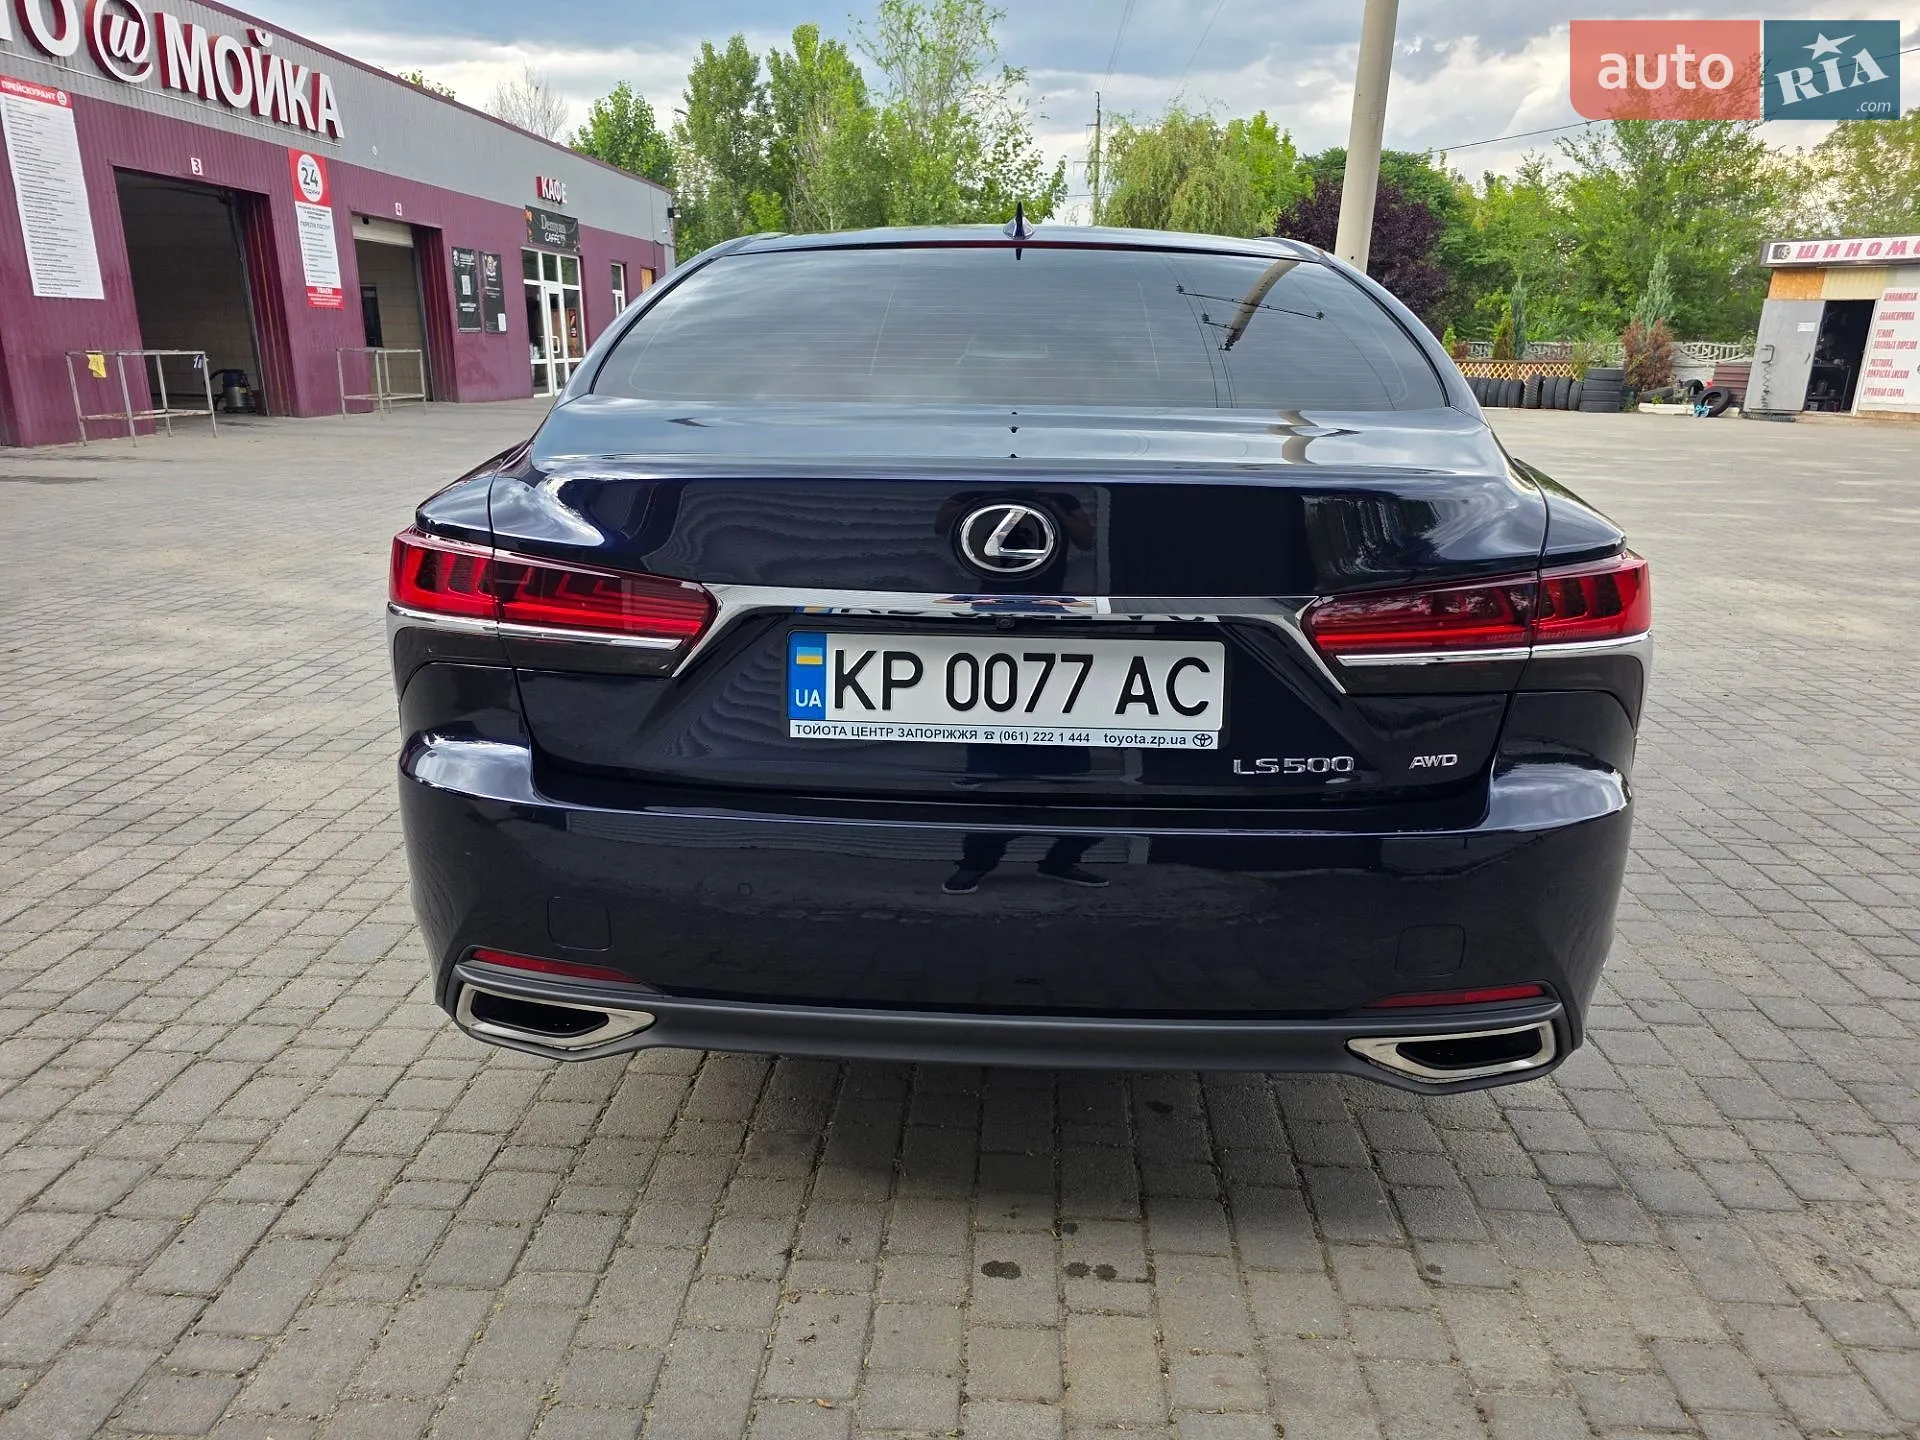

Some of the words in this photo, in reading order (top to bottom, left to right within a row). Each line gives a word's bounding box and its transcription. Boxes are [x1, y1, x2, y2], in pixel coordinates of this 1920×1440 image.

[0, 0, 80, 57] О
[157, 12, 345, 139] МОЙКА
[192, 159, 201, 174] 3
[301, 167, 319, 188] 24
[537, 175, 568, 204] КАФЕ
[834, 649, 924, 711] KP
[945, 652, 1094, 714] 0077
[1114, 655, 1210, 717] AC
[795, 689, 822, 708] UA
[795, 723, 847, 736] ТОЙОТА
[851, 726, 894, 739] ЦЕНТР
[897, 728, 978, 740] ЗАПОРІЖЖЯ
[999, 730, 1029, 743] (061)
[1033, 731, 1054, 742] 222
[1058, 732, 1064, 742] 1
[1068, 732, 1090, 743] 444
[1103, 733, 1187, 747] toyota.zp.ua
[1408, 753, 1458, 770] AWD
